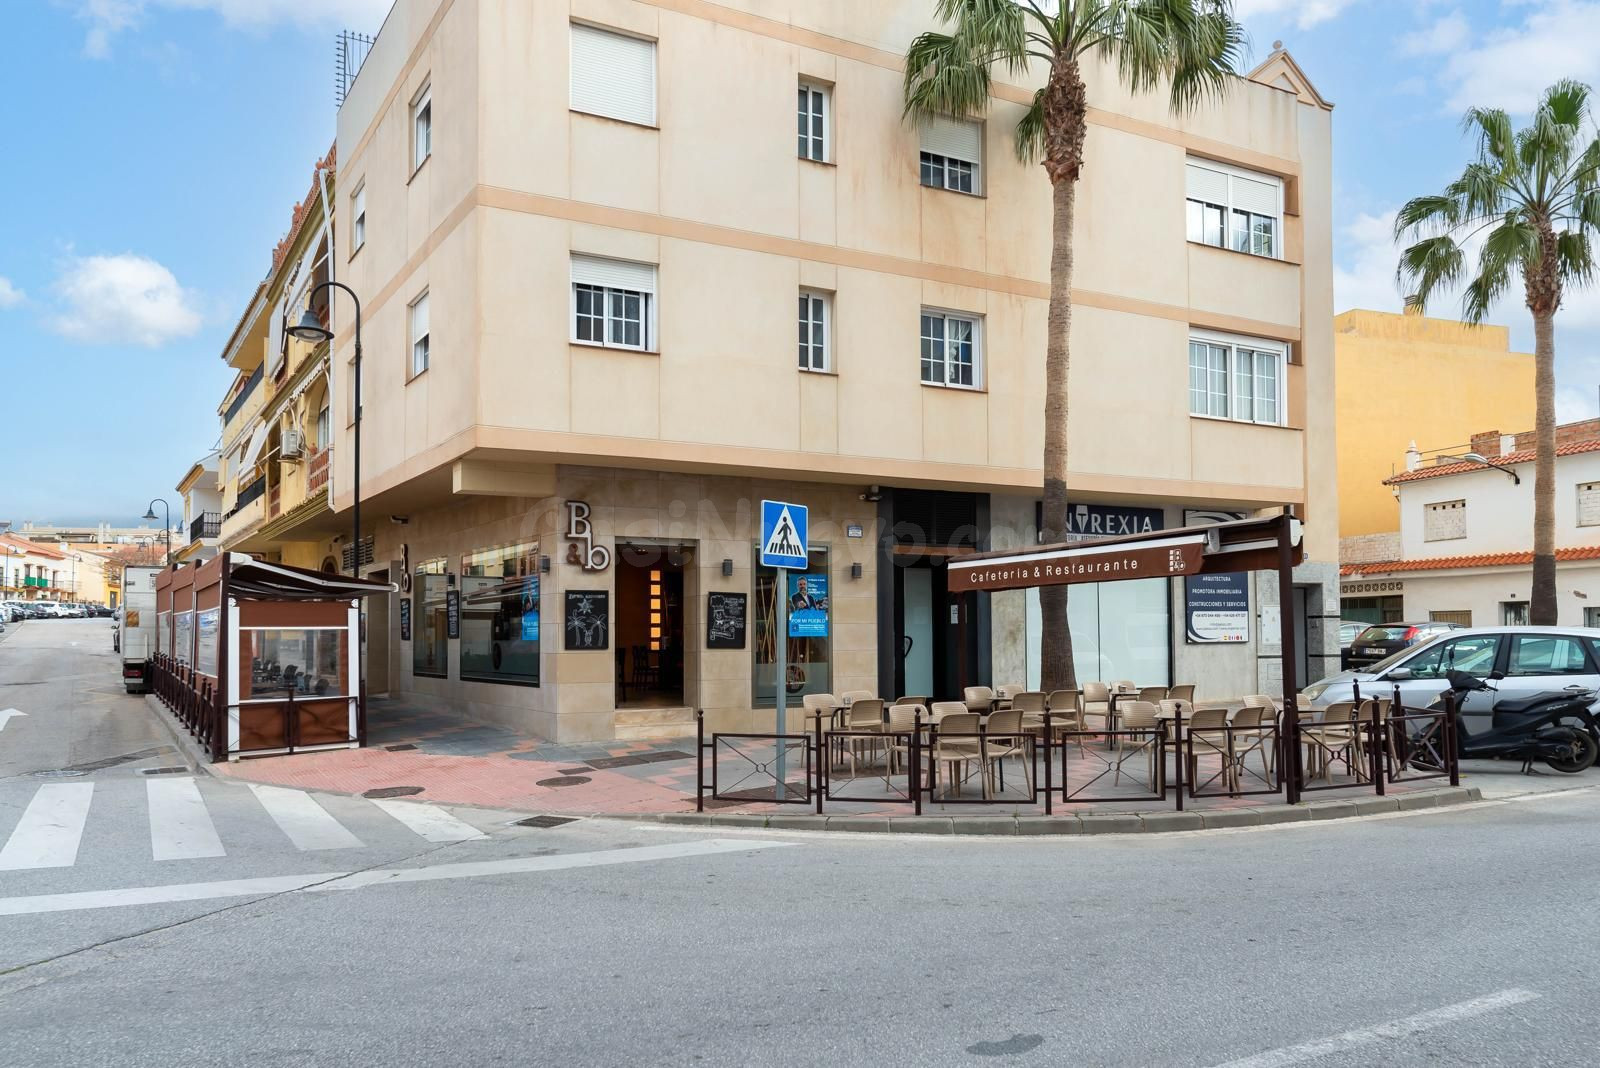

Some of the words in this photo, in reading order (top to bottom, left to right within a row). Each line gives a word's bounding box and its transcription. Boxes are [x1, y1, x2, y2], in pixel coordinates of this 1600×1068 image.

[1066, 505, 1153, 534] NTREXIA
[970, 568, 1028, 583] Cafeteria
[1033, 566, 1041, 577] &
[1046, 559, 1138, 576] Restaurante
